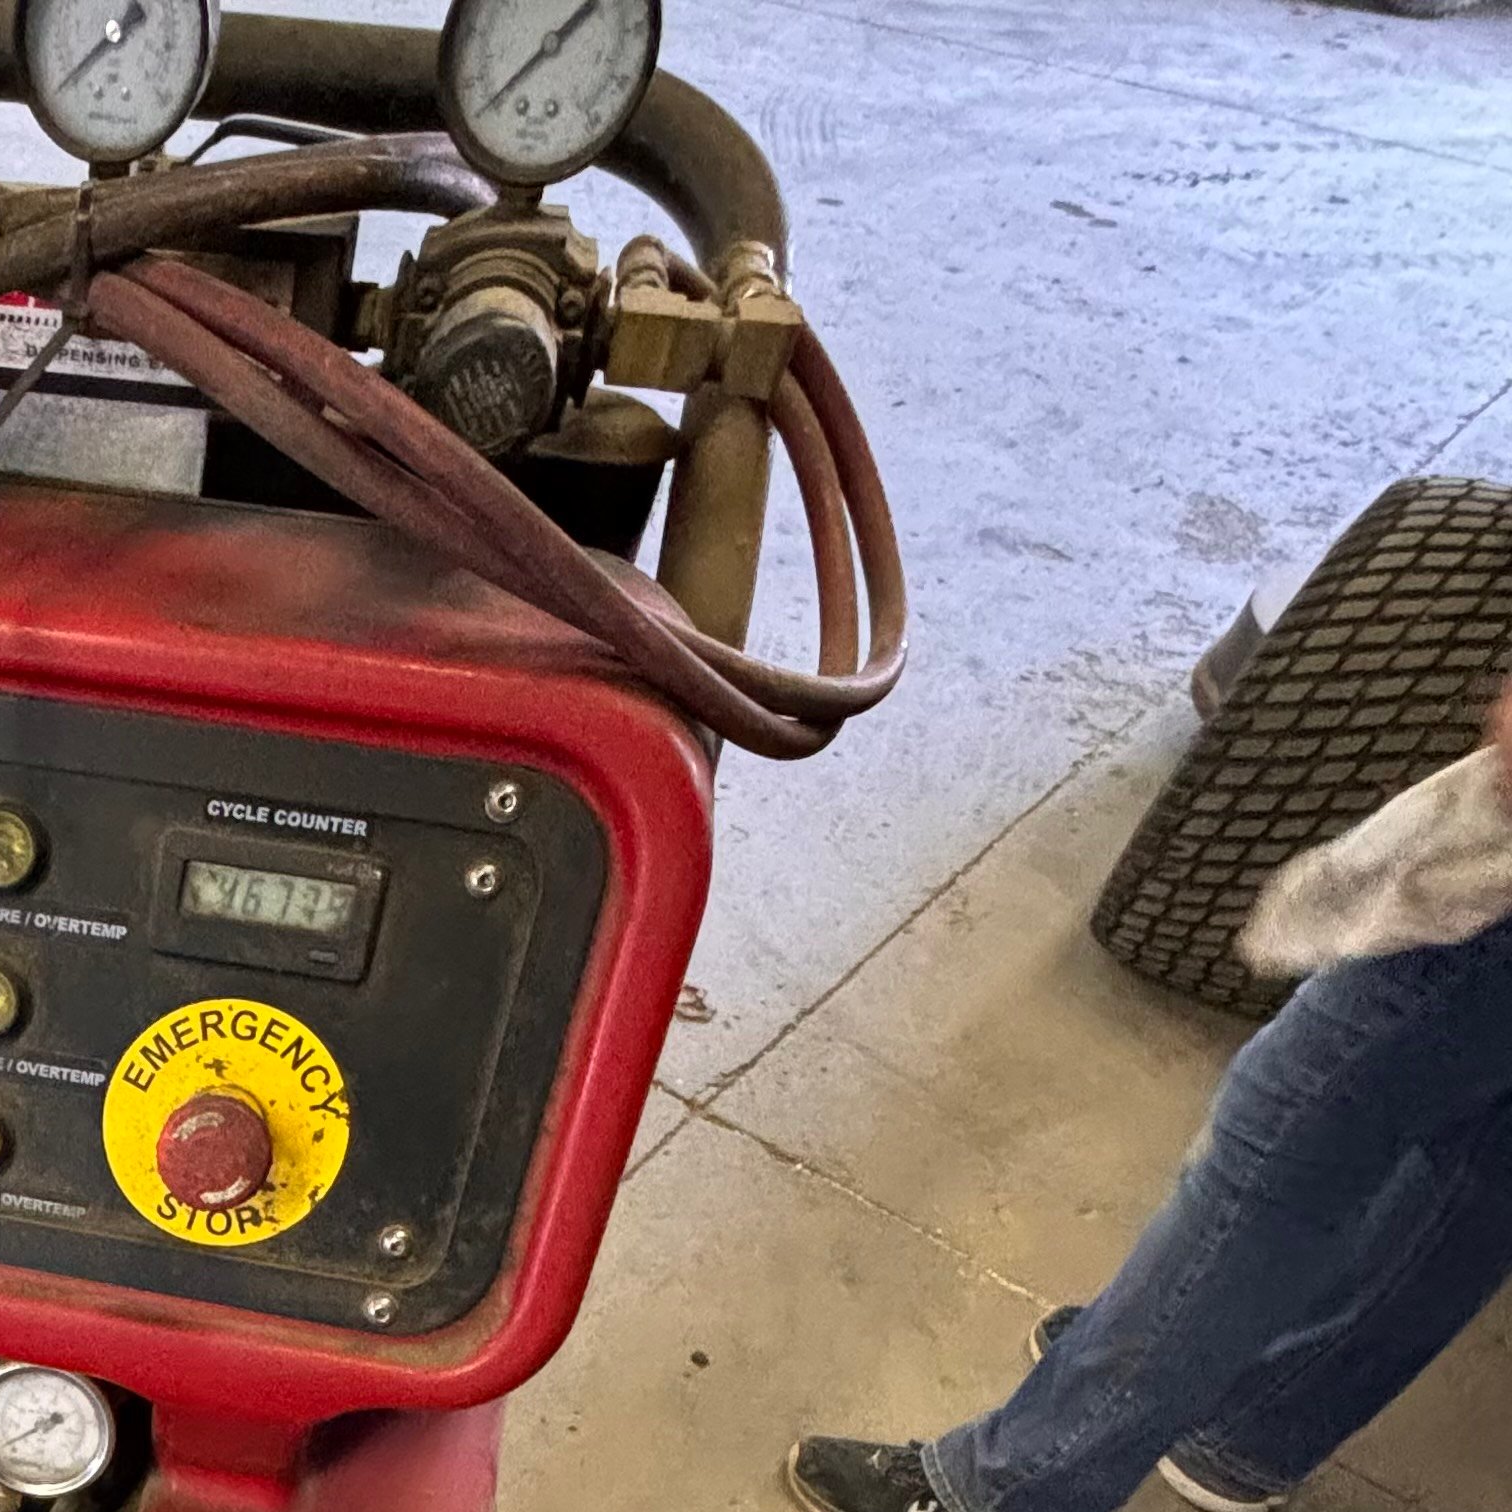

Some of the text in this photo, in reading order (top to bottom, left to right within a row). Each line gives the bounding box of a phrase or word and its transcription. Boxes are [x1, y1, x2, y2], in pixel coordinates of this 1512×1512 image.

[27, 343, 141, 368] DPENSING
[207, 799, 368, 837] CYCLE COUNTER
[34, 913, 128, 940] OVERTEMP
[16, 1060, 106, 1087] OVERTEMP
[123, 1009, 346, 1114] EMERGENCY
[1, 1192, 88, 1219] OVERTEMP
